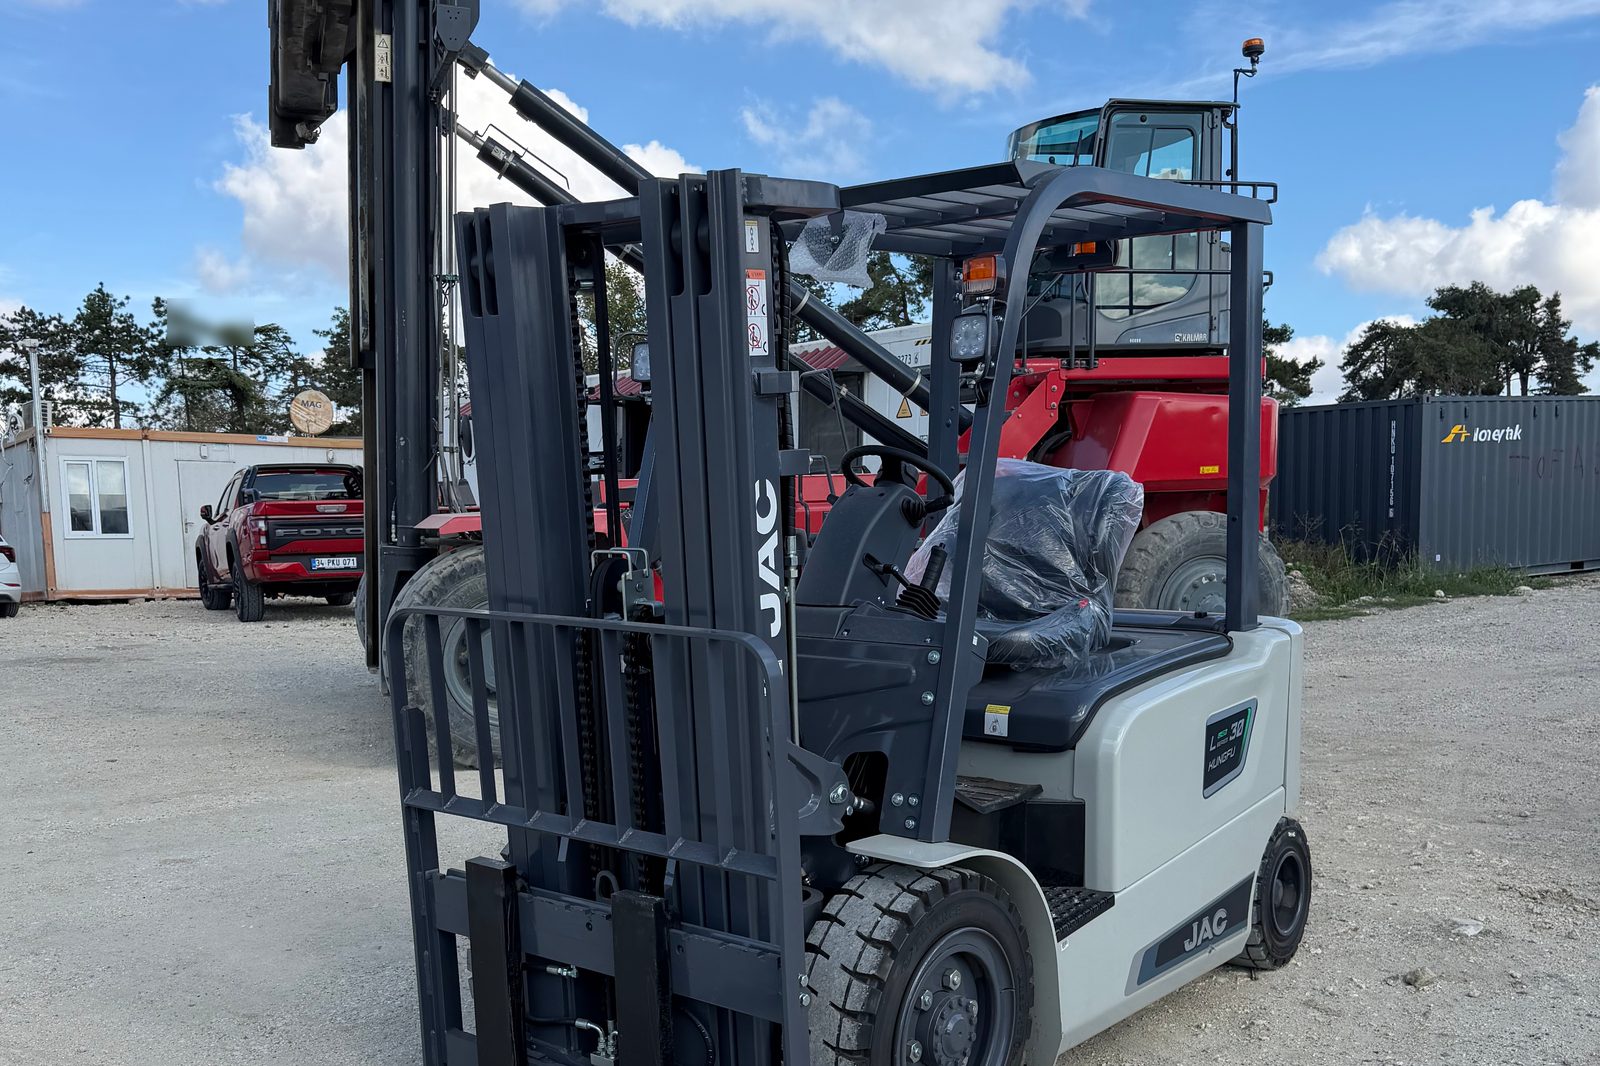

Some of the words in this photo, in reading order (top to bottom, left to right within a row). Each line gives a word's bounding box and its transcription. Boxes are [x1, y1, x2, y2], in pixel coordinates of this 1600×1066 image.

[1182, 333, 1207, 342] KALMAR
[301, 400, 322, 409] MAG
[316, 559, 325, 567] 34
[327, 559, 340, 567] PKU
[342, 558, 356, 566] 071
[754, 478, 782, 638] JAC
[1207, 746, 1236, 772] KUNGFU
[1183, 908, 1228, 952] JAC
